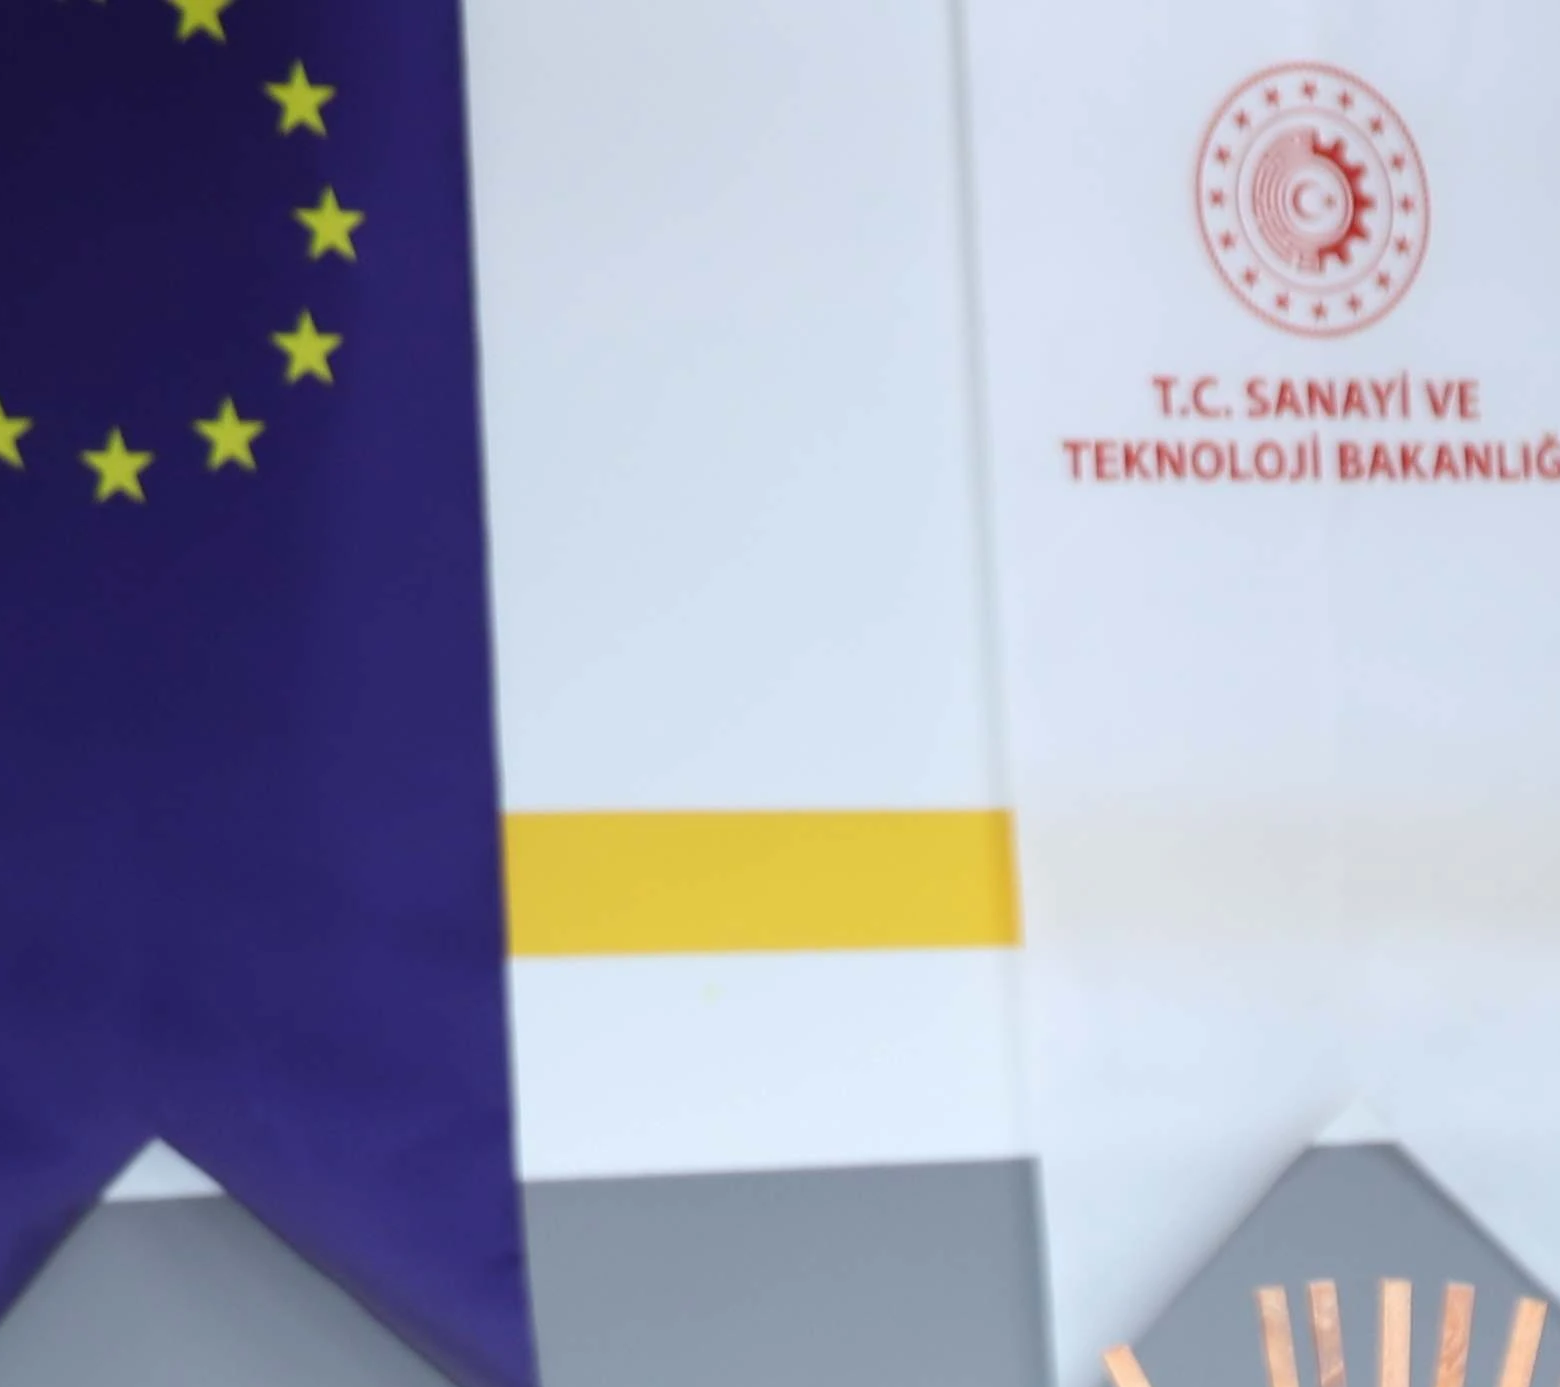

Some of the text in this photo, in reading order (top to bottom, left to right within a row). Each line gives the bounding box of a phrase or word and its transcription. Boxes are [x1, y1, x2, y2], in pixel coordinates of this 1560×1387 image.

[1151, 370, 1481, 421] T.C. SANAYİ VE
[1062, 433, 1321, 483] TEKNOLOJİ
